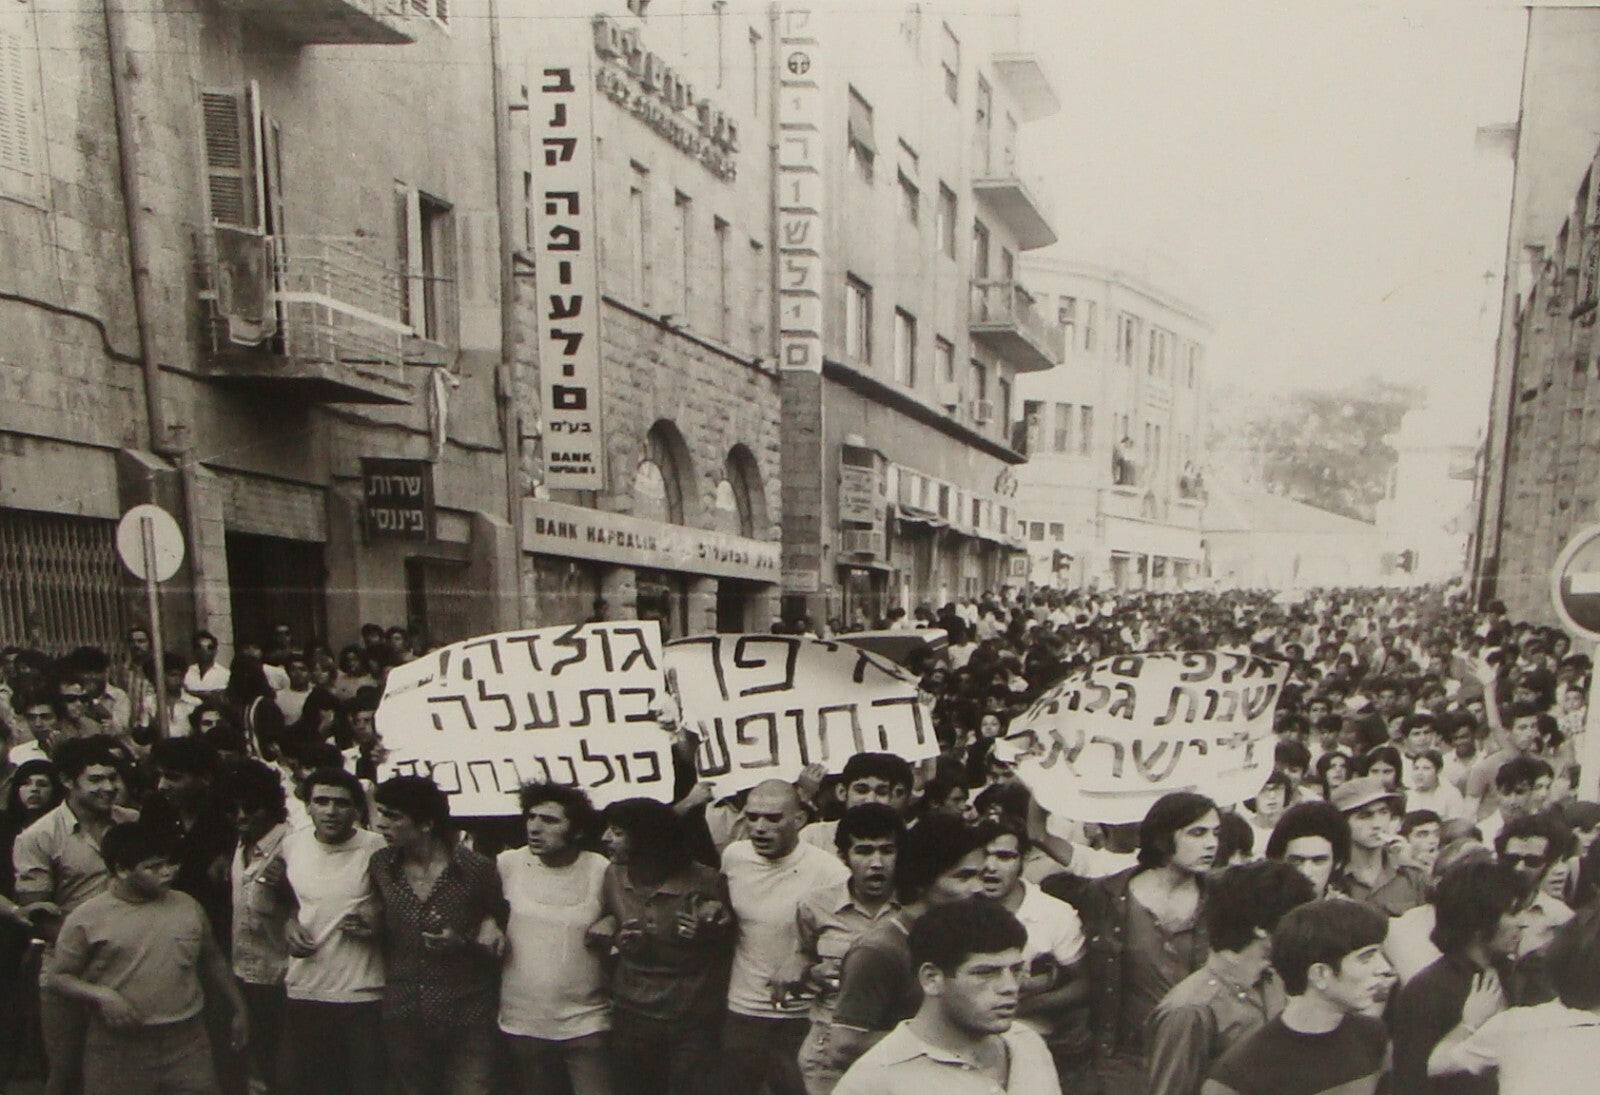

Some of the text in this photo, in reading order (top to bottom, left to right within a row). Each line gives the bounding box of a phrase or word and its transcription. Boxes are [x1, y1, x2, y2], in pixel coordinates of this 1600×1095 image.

[542, 68, 587, 410] בנק הפועלים
[551, 452, 591, 463] BANK
[368, 475, 422, 496] שרות
[370, 508, 424, 531] פיננסי
[535, 517, 578, 539] BANK
[1153, 683, 1278, 726] שנות
[699, 697, 926, 777] החופש
